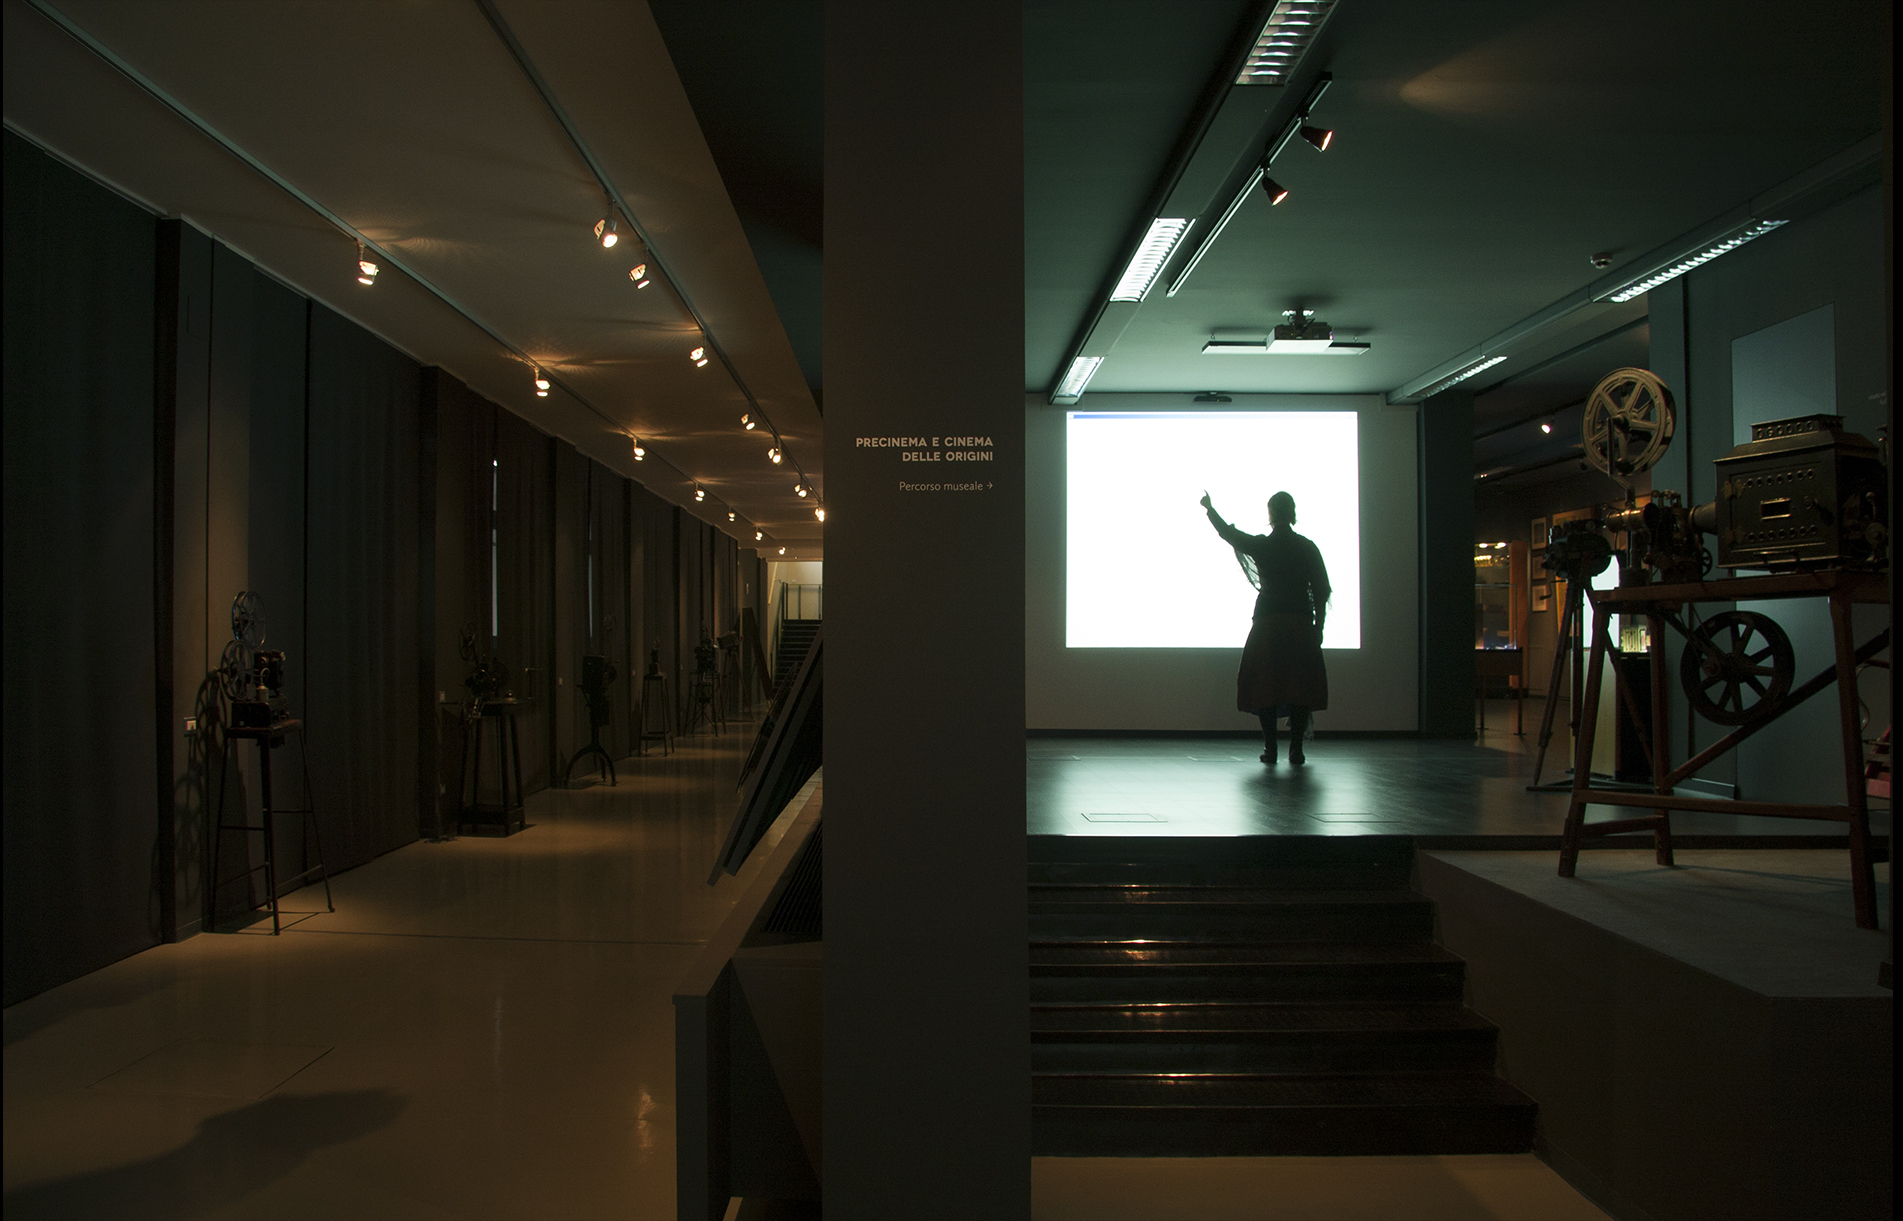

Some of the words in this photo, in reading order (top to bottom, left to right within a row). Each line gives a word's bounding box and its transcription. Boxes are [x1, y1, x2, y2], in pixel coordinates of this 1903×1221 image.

[855, 437, 928, 448] PRECINEMA
[932, 437, 940, 447] E
[944, 436, 994, 447] CINEMA
[902, 451, 941, 462] DELLE
[945, 451, 994, 462] ORIGINI
[899, 481, 941, 491] Percorso
[943, 480, 984, 491] museale
